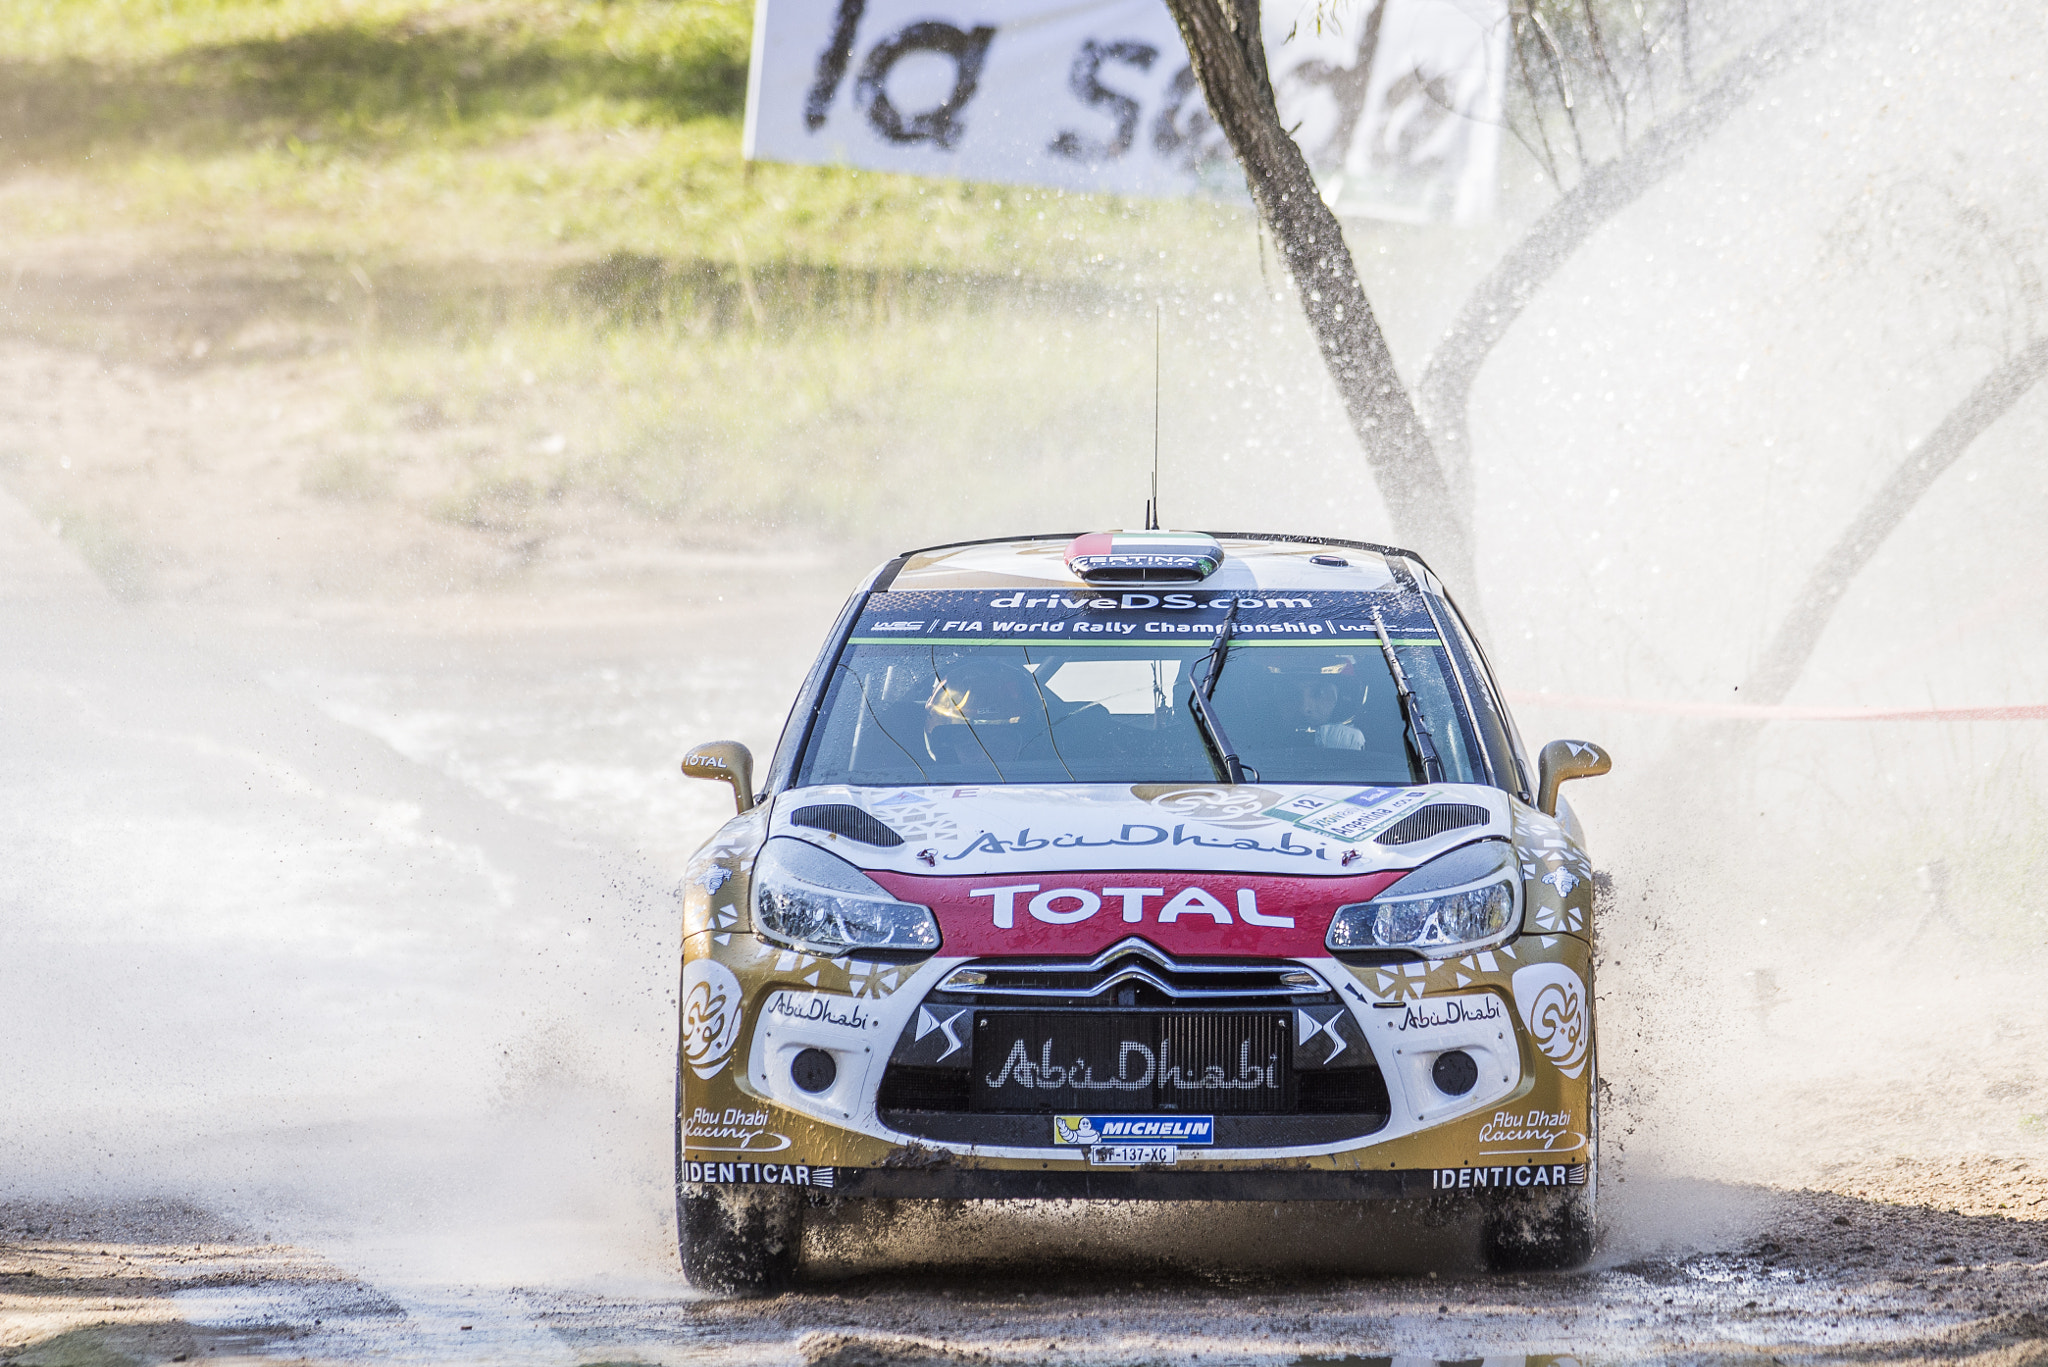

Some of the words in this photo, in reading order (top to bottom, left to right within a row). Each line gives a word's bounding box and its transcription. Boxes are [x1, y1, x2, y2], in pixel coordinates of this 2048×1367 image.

[806, 0, 995, 150] la
[990, 592, 1313, 609] driveDS.com
[942, 621, 983, 631] FIA
[993, 621, 1064, 632] World
[1073, 621, 1136, 633] Rally
[1145, 621, 1323, 634] Championship
[685, 754, 728, 768] TOTAL
[1331, 808, 1393, 836] Argentina
[970, 883, 1295, 929] TOTAL
[692, 1107, 719, 1124] Abu
[722, 1109, 769, 1126] Dhabi
[1493, 1111, 1524, 1127] Abu
[1526, 1110, 1572, 1127] Dhabi
[1102, 1122, 1210, 1135] MICHELIN
[1479, 1123, 1567, 1150] Racing
[1096, 1147, 1167, 1161] F-137-XC
[685, 1162, 809, 1186] IDENTICAR
[1433, 1165, 1566, 1190] IDENTICAR
